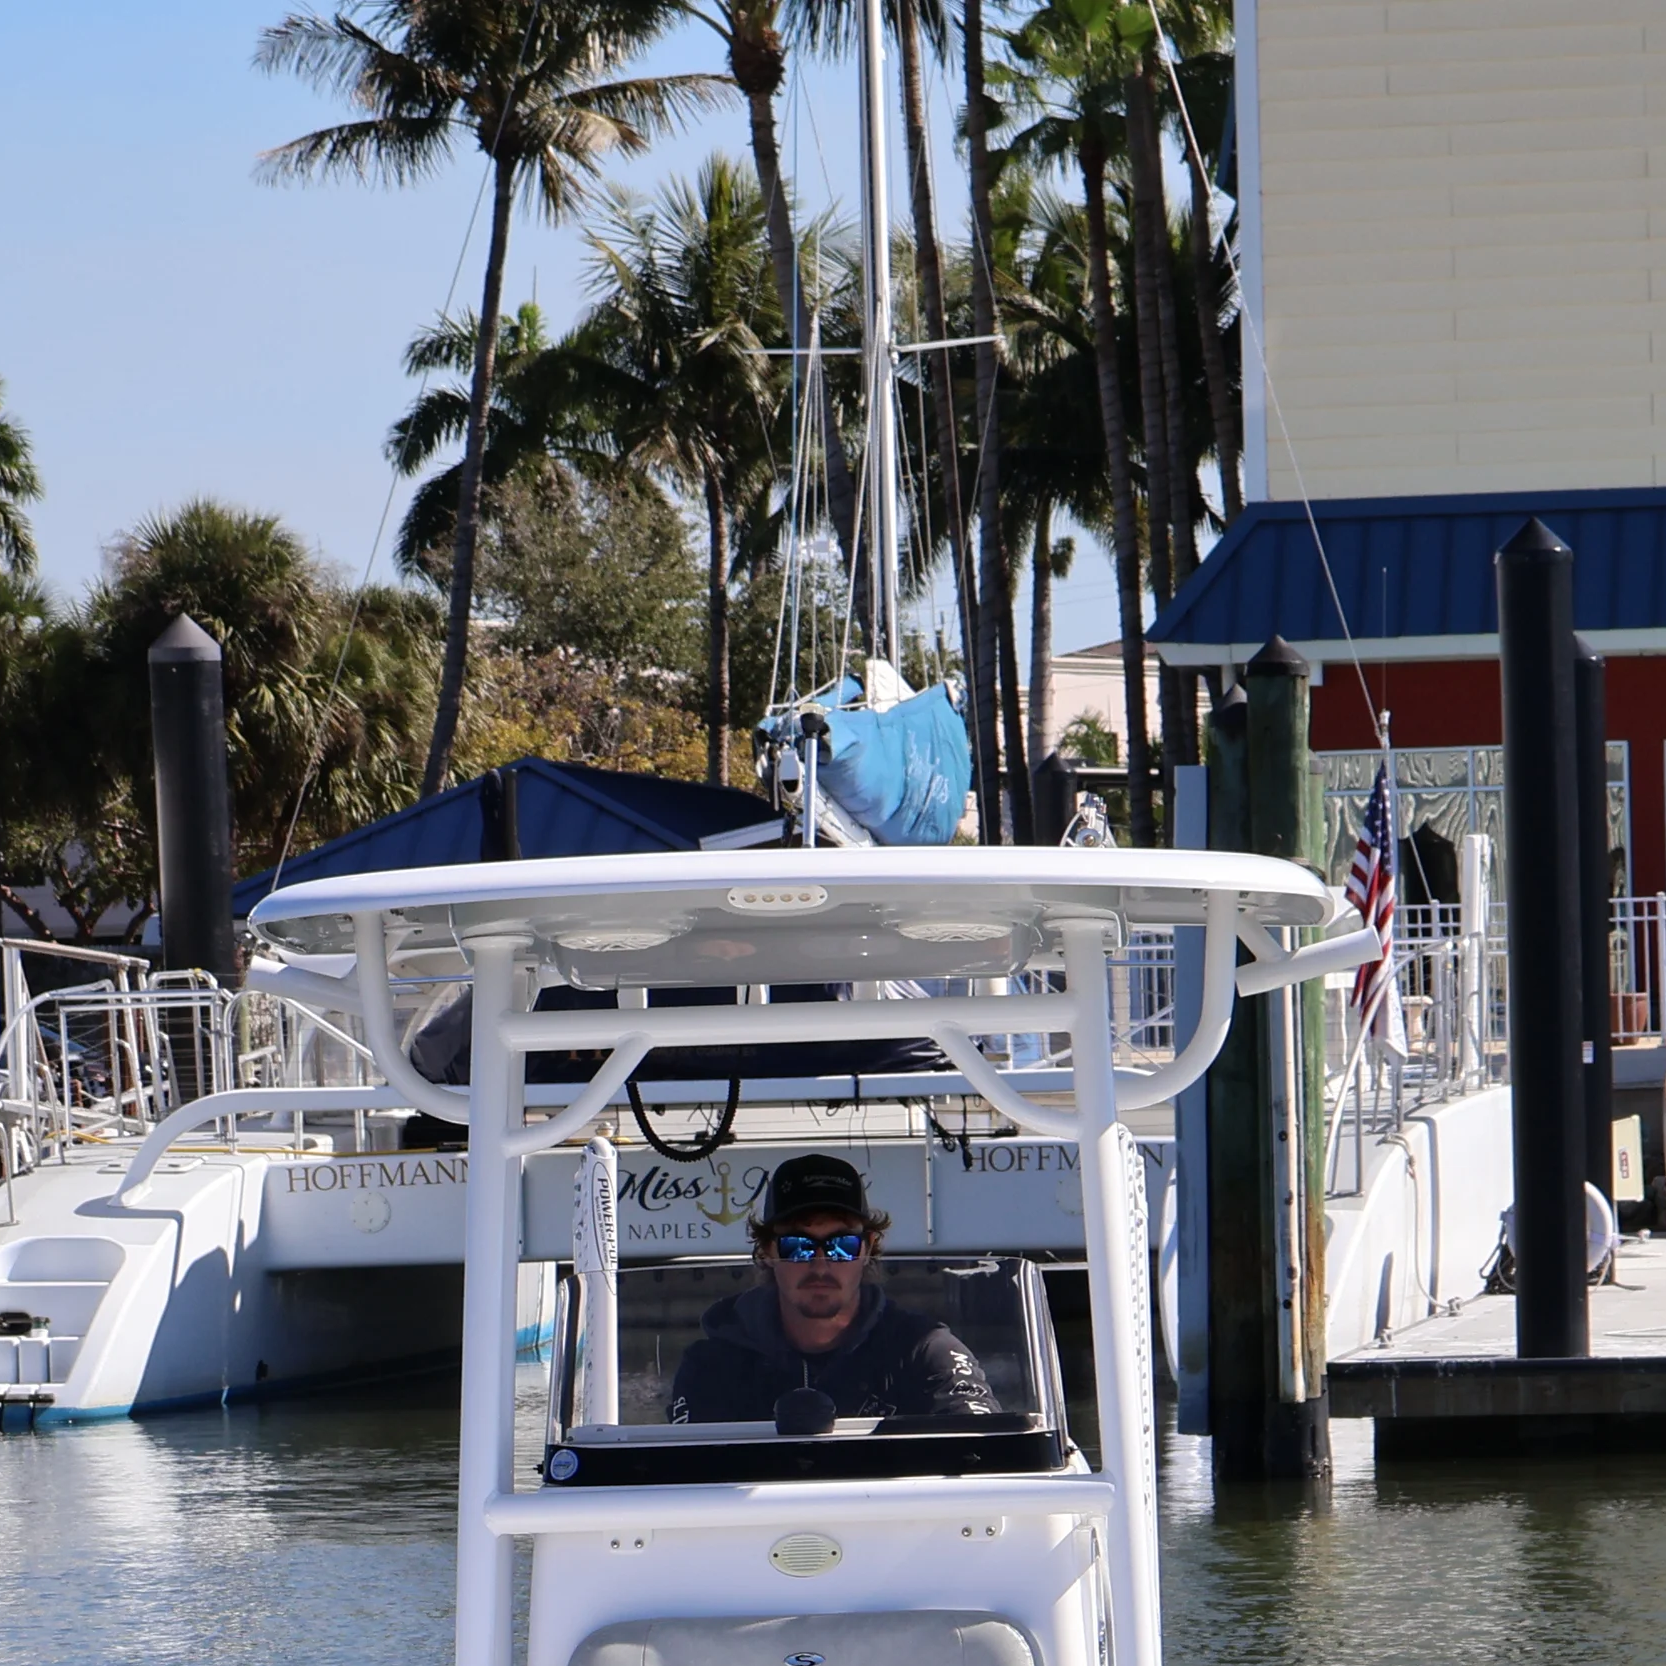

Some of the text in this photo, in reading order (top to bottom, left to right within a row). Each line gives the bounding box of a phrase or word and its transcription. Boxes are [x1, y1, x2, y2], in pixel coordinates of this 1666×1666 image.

[962, 1144, 1166, 1173] HOFFMN
[618, 1166, 710, 1212] Miss
[597, 1177, 618, 1273] POWER-POL
[628, 1222, 712, 1241] NAPLES
